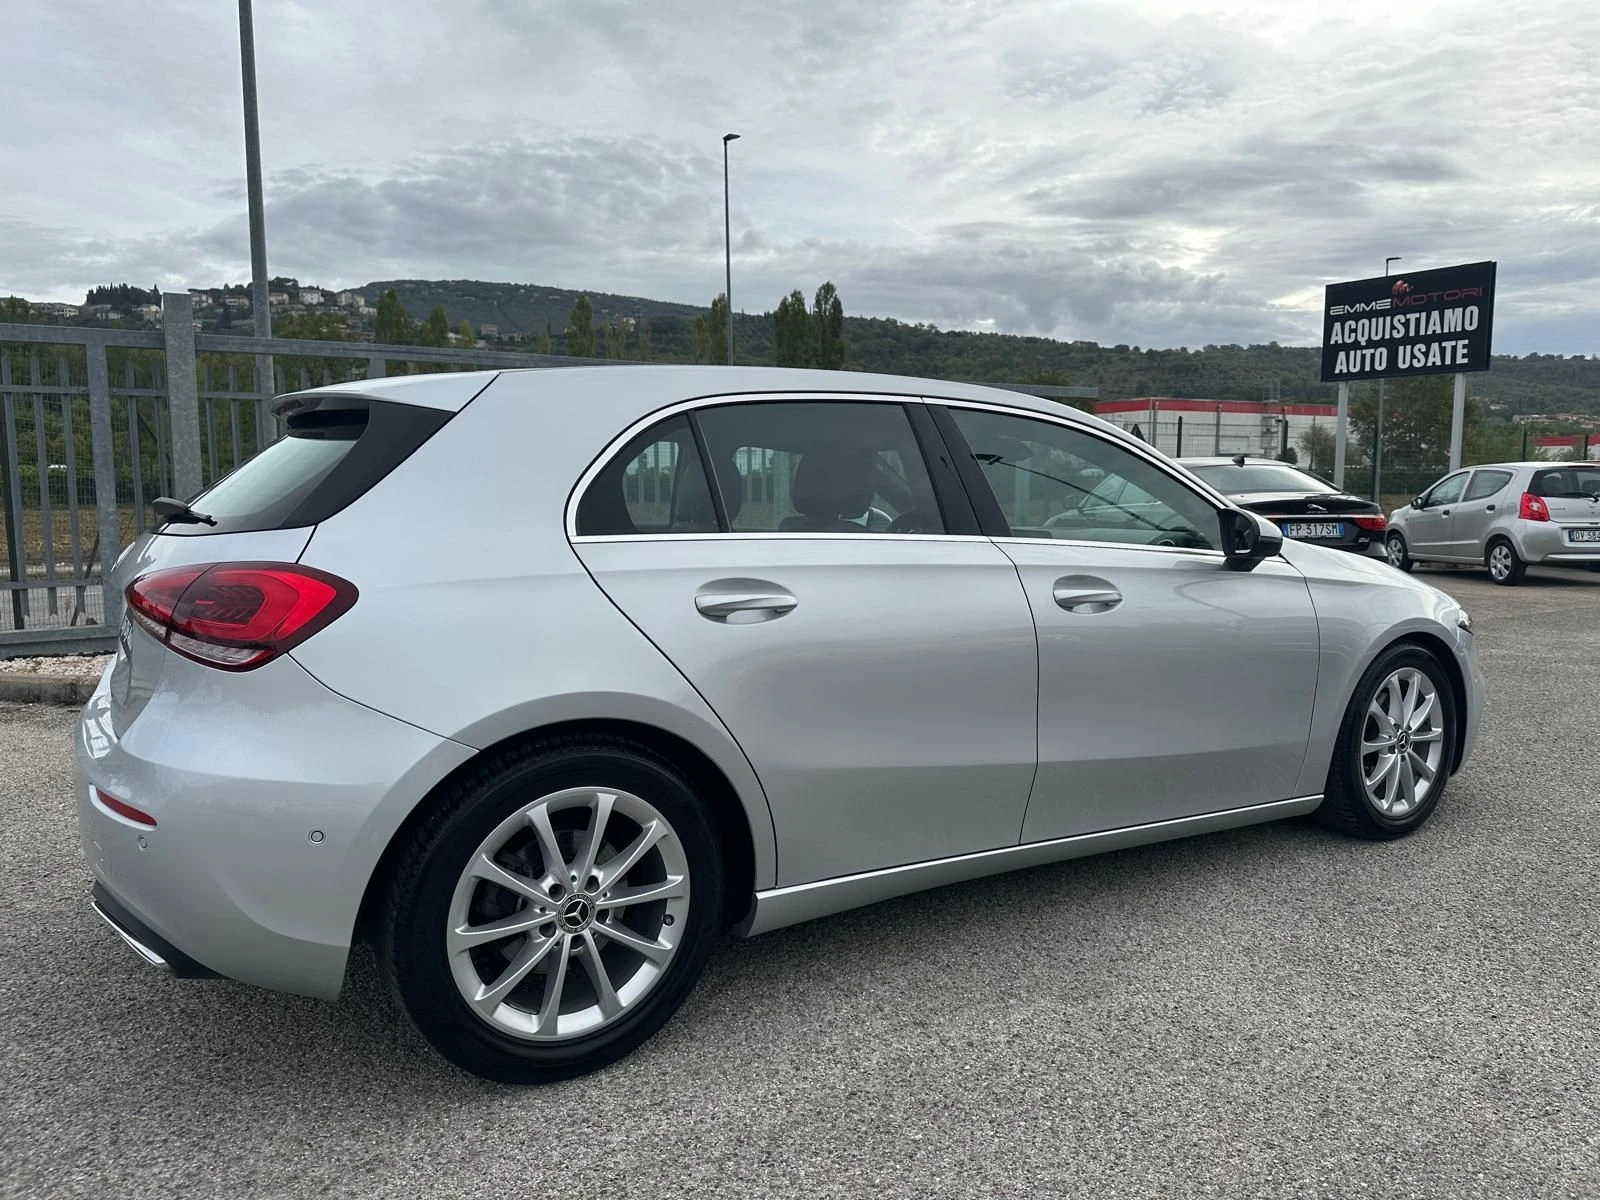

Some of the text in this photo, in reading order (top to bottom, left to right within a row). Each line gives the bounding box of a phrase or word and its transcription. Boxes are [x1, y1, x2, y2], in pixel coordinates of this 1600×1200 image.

[1330, 287, 1483, 316] EMME MOTORI
[1330, 305, 1479, 346] ACQUISTIAMO
[1334, 339, 1469, 374] AUTO USATE
